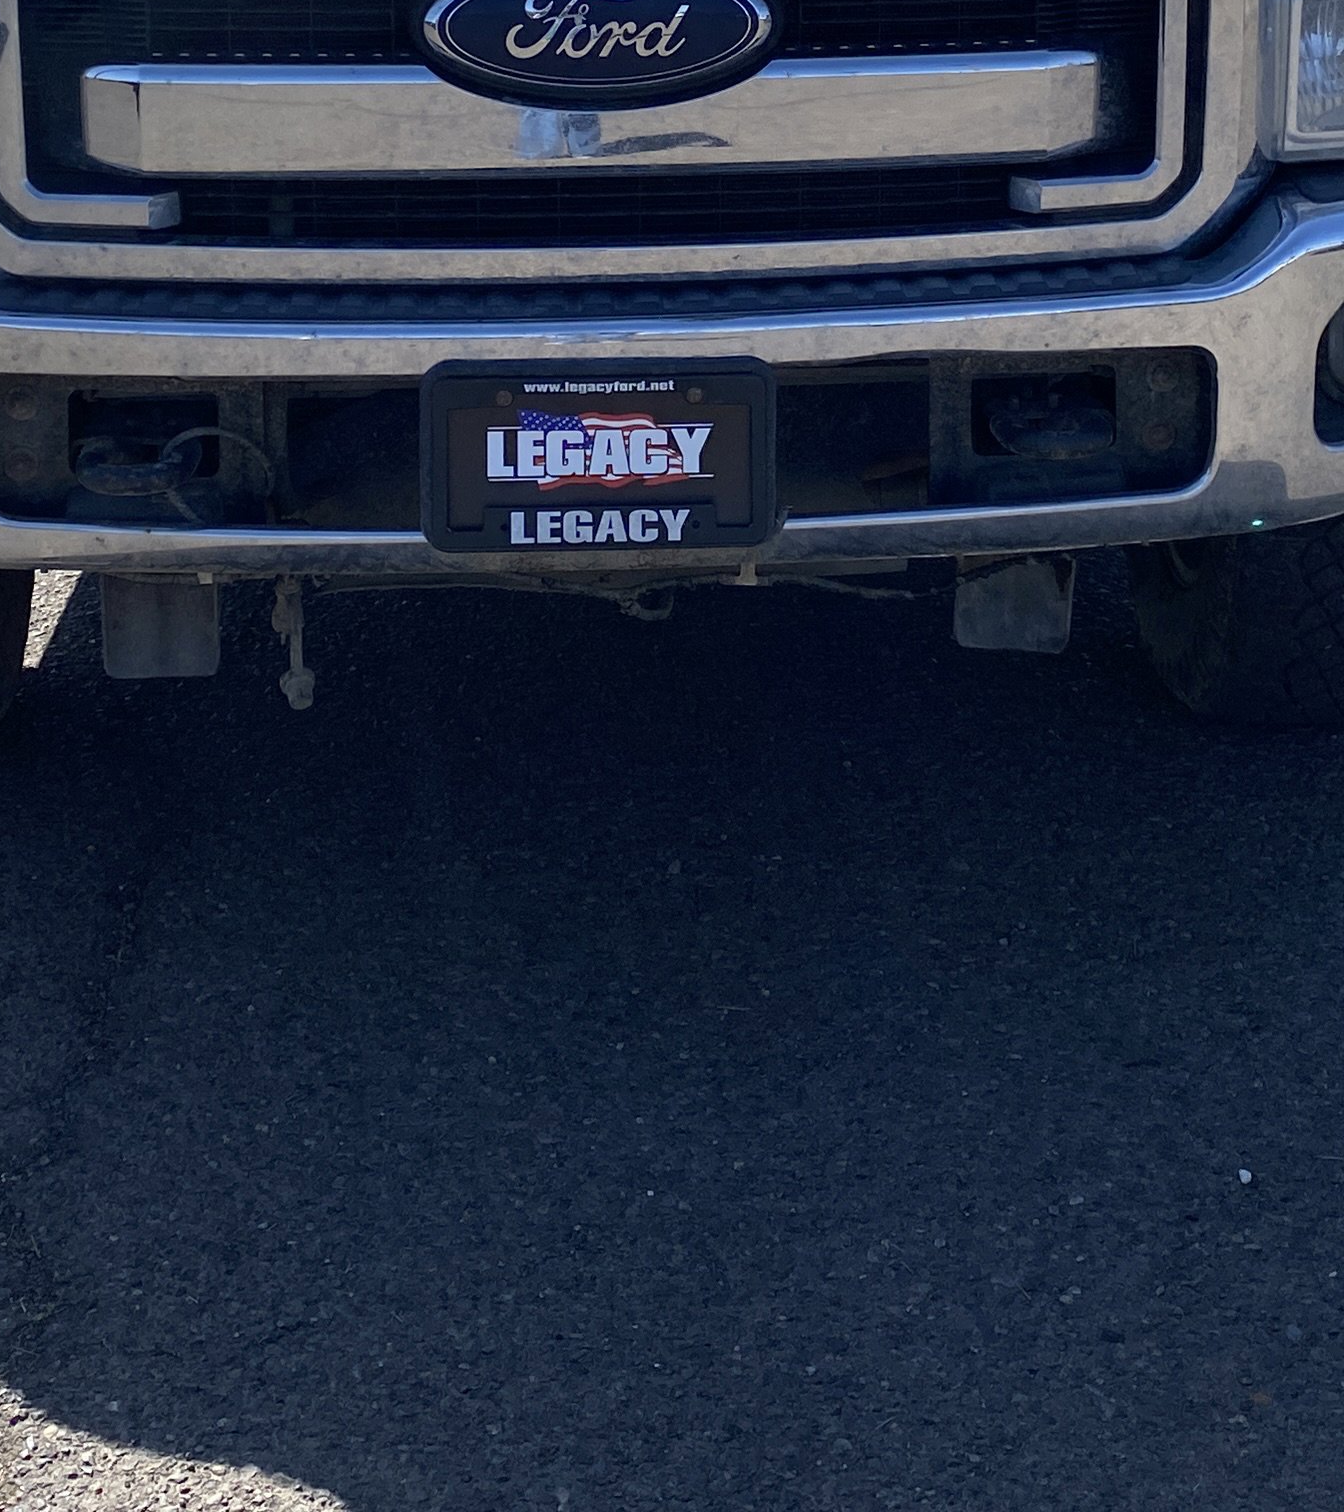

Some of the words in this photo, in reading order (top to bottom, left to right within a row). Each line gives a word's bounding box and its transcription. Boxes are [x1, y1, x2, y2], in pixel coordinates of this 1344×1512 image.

[523, 380, 675, 395] www.legacyford.net
[487, 427, 711, 477] LEGACY
[510, 509, 690, 545] LEGACY
